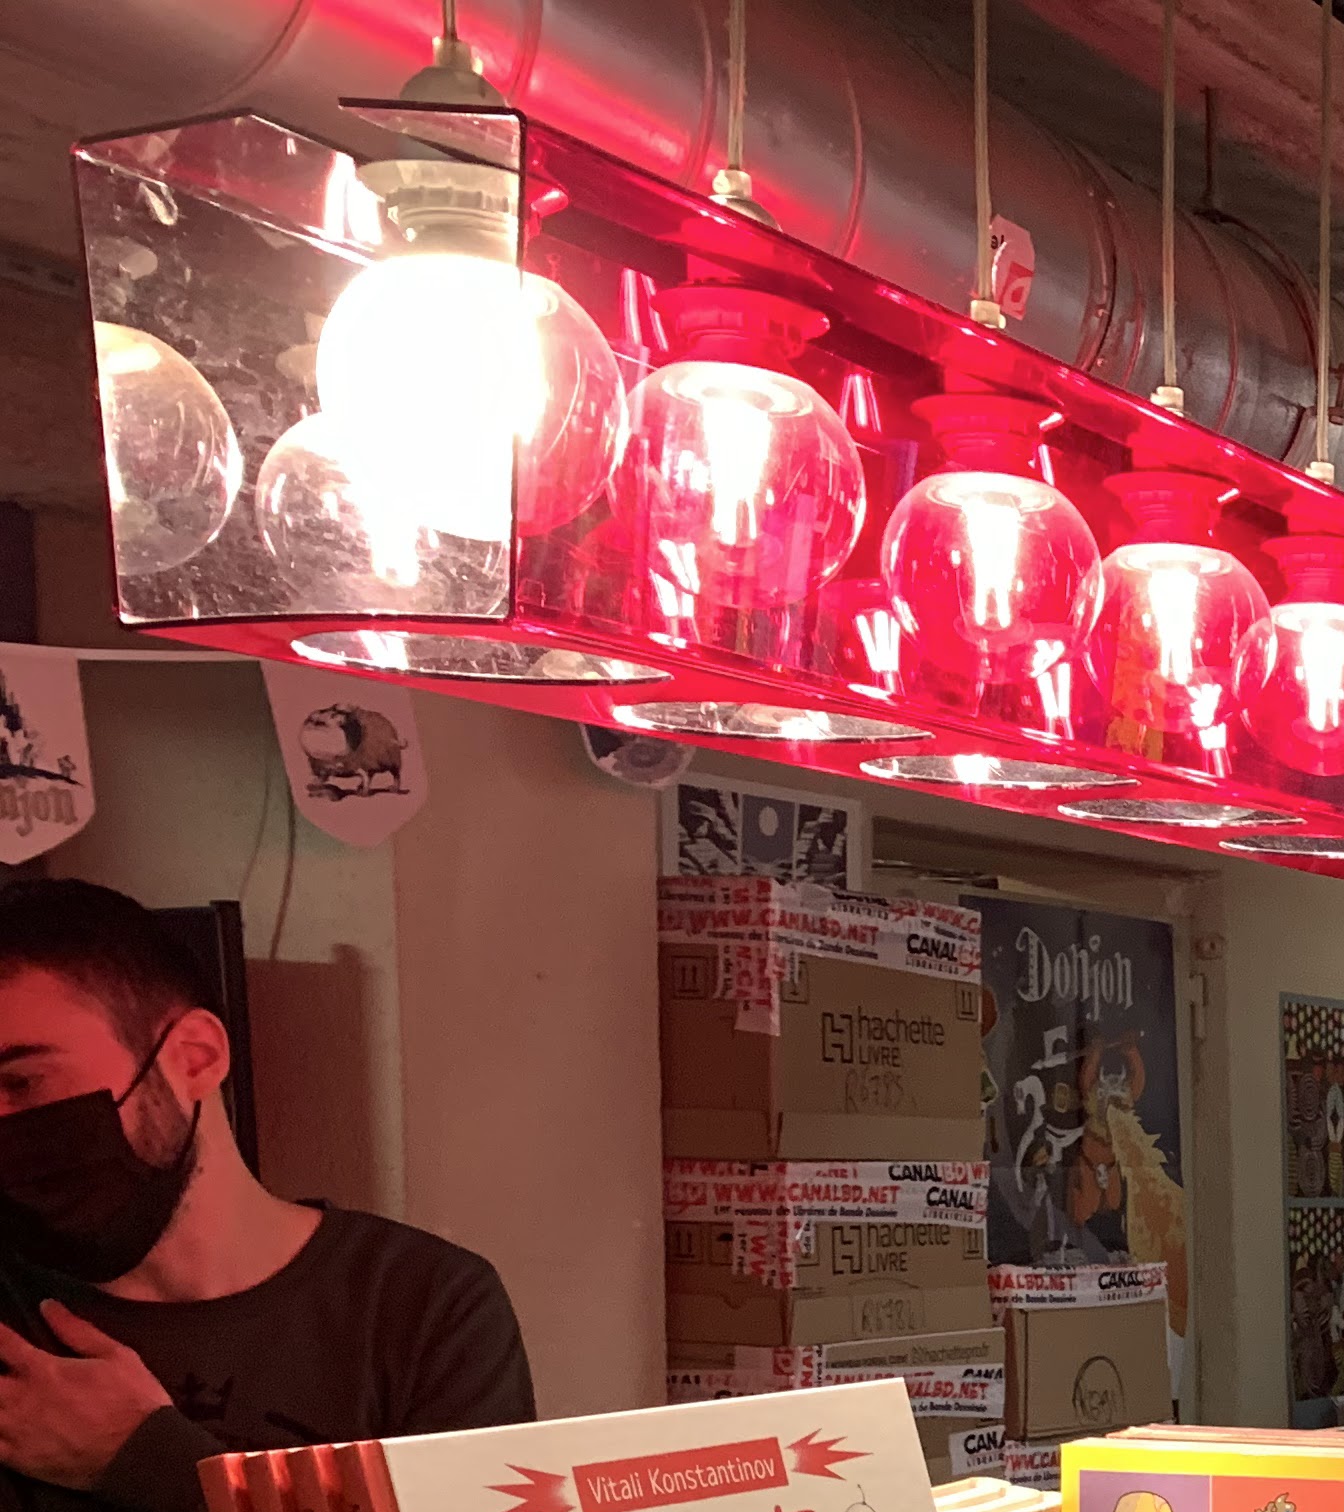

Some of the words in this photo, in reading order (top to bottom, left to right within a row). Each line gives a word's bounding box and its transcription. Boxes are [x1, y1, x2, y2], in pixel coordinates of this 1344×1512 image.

[1016, 926, 1133, 1021] Donjon
[859, 1006, 946, 1046] hachette
[860, 1046, 900, 1068] LIVRE
[713, 1183, 900, 1205] WWW.CANALBD.NET
[868, 1251, 908, 1273] LIVRE
[588, 1471, 643, 1505] Vitali
[648, 1455, 777, 1496] Konstantinov
